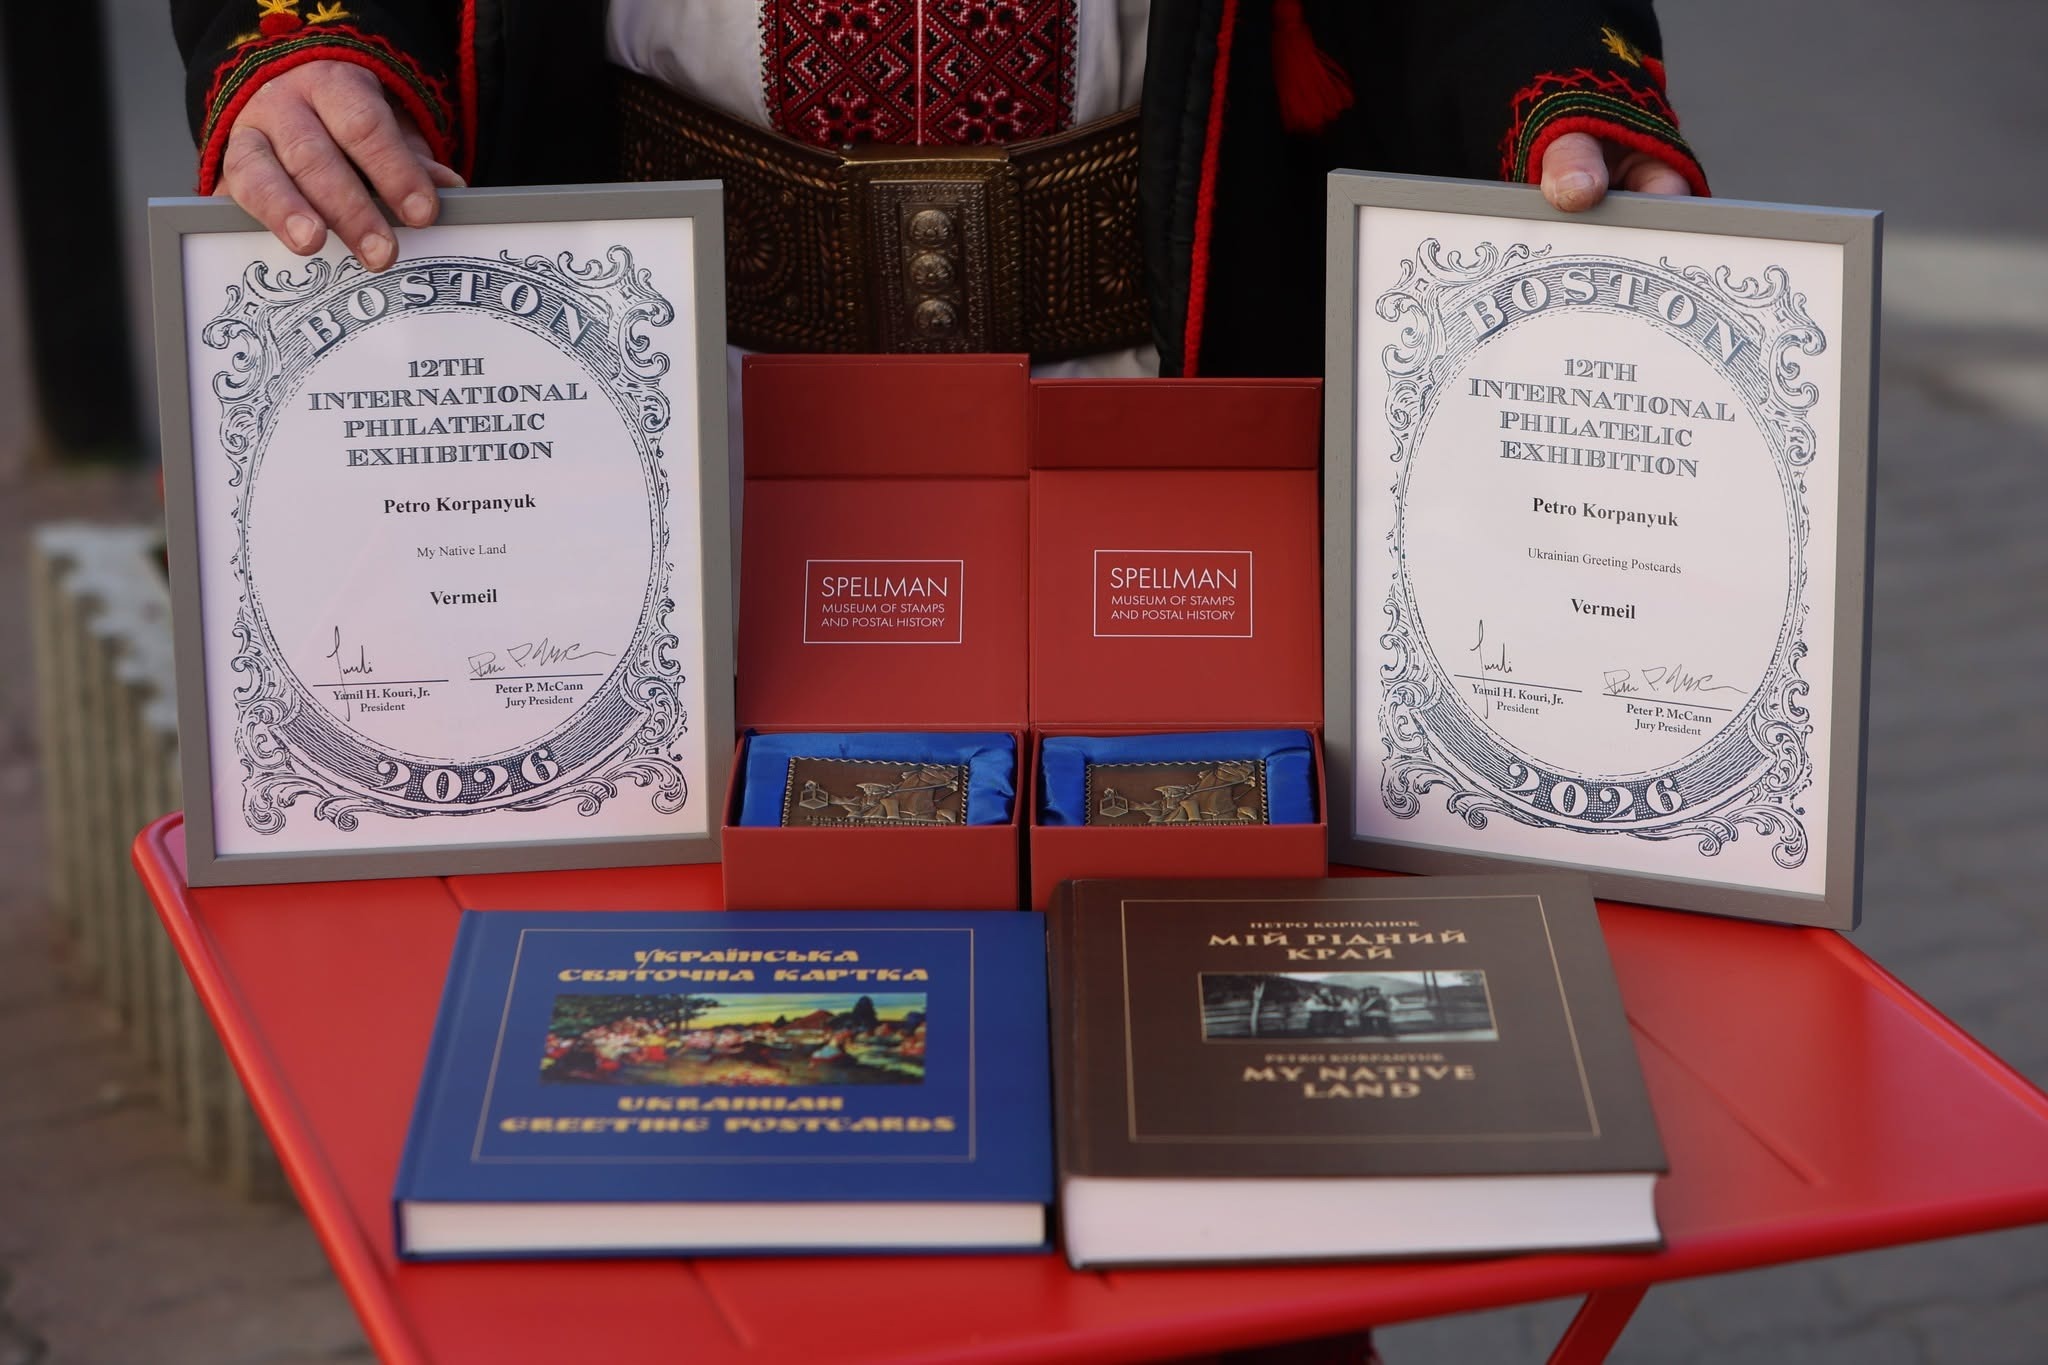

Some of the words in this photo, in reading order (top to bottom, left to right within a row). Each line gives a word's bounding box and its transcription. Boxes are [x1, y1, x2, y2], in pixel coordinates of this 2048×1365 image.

[296, 269, 598, 358] BOSTON
[1458, 265, 1752, 366] BOSTON
[407, 357, 485, 378] 12TH
[1564, 359, 1638, 382] 12TH
[308, 382, 587, 411] INTERNATIONAL
[1468, 378, 1735, 423] INTERNATIONAL
[343, 412, 545, 439] PHILATELIC
[1499, 411, 1693, 447] PHILATELIC
[346, 441, 553, 467] EXHIBITION
[1500, 440, 1699, 478] EXHIBITION
[384, 499, 430, 514] Petro
[436, 494, 536, 514] Korpanyuk
[1532, 497, 1577, 516] Petro
[1582, 502, 1679, 528] Korpanyuk
[417, 546, 435, 559] My
[439, 545, 474, 556] Native
[479, 544, 506, 555] Land
[1528, 548, 1579, 564] Ukrainian
[1582, 554, 1628, 570] Greeting
[1631, 558, 1682, 574] Postcards
[821, 576, 948, 598] SPELLMAN
[1110, 567, 1237, 590] SPELLMAN
[430, 589, 498, 605] Vermeil
[1111, 595, 1167, 606] MUSEUM
[1169, 596, 1187, 607] OF
[1189, 596, 1235, 607] STAMPS
[821, 603, 877, 614] MUSEUM
[880, 603, 898, 614] OF
[900, 603, 945, 614] STAMPS
[1110, 609, 1139, 620] AND
[1141, 609, 1185, 620] POSTAL
[1187, 609, 1236, 621] HISTORY
[1570, 598, 1636, 619] Vermeil
[821, 617, 849, 628] AND
[852, 617, 894, 628] POSTAL
[896, 617, 946, 628] HISTORY
[333, 689, 364, 701] Yamil
[366, 689, 380, 699] H.
[495, 684, 521, 694] Peter
[524, 682, 536, 693] P.
[537, 681, 583, 692] McCann
[1472, 684, 1500, 698] Yamil
[1503, 688, 1516, 698] H.
[360, 702, 405, 713] President
[505, 698, 526, 708] Jury
[528, 695, 573, 706] President
[1496, 701, 1539, 715] President
[1626, 704, 1653, 716] Peter
[1655, 708, 1666, 718] P.
[1668, 708, 1712, 724] McCann
[1634, 719, 1656, 732] Jury
[1658, 722, 1701, 736] President
[370, 748, 559, 802] 2026
[1502, 763, 1683, 822] 2026
[1208, 932, 1290, 946] МІЙ
[1305, 930, 1468, 946] РІДНИЙ
[634, 948, 859, 968] УКРАЇНСЬКА
[1287, 946, 1394, 960] КРАЙ
[558, 968, 755, 982] СВЯТОЧНА
[774, 968, 928, 982] КАРТКА
[1243, 1066, 1303, 1081] MY
[1319, 1065, 1475, 1080] NATIVE
[1304, 1083, 1421, 1099] LAND
[618, 1096, 844, 1111] UKRAINIAN
[725, 1116, 956, 1132] POSTCARDS
